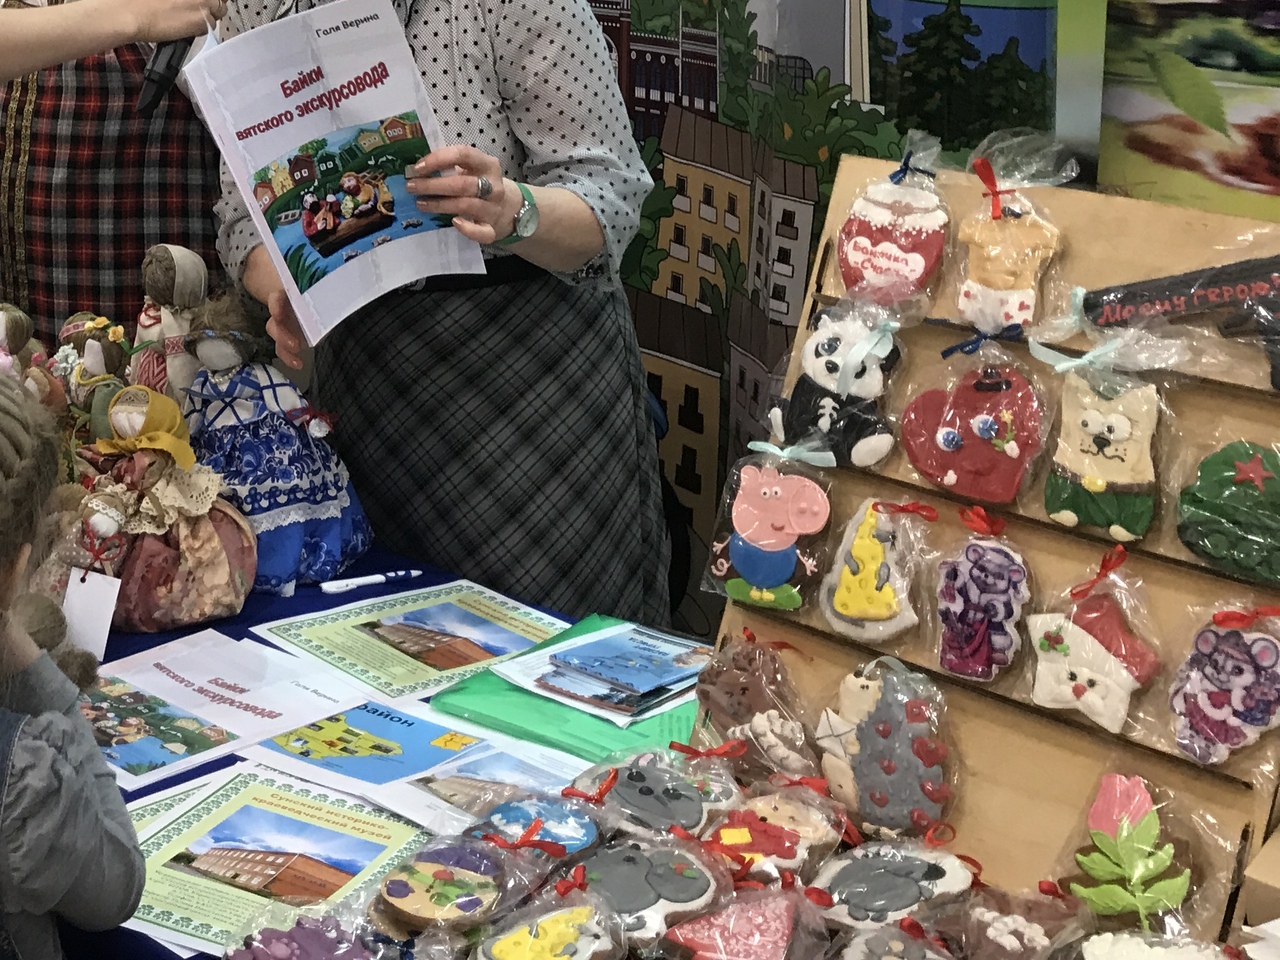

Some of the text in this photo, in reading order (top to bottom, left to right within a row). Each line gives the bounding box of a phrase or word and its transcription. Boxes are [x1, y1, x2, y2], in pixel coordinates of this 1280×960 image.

[315, 12, 381, 38] Галя Верина
[279, 65, 325, 99] Байки
[235, 61, 390, 141] вятского экскурсовода
[252, 796, 392, 841] краеведческий музей
[270, 793, 324, 812] Сунский
